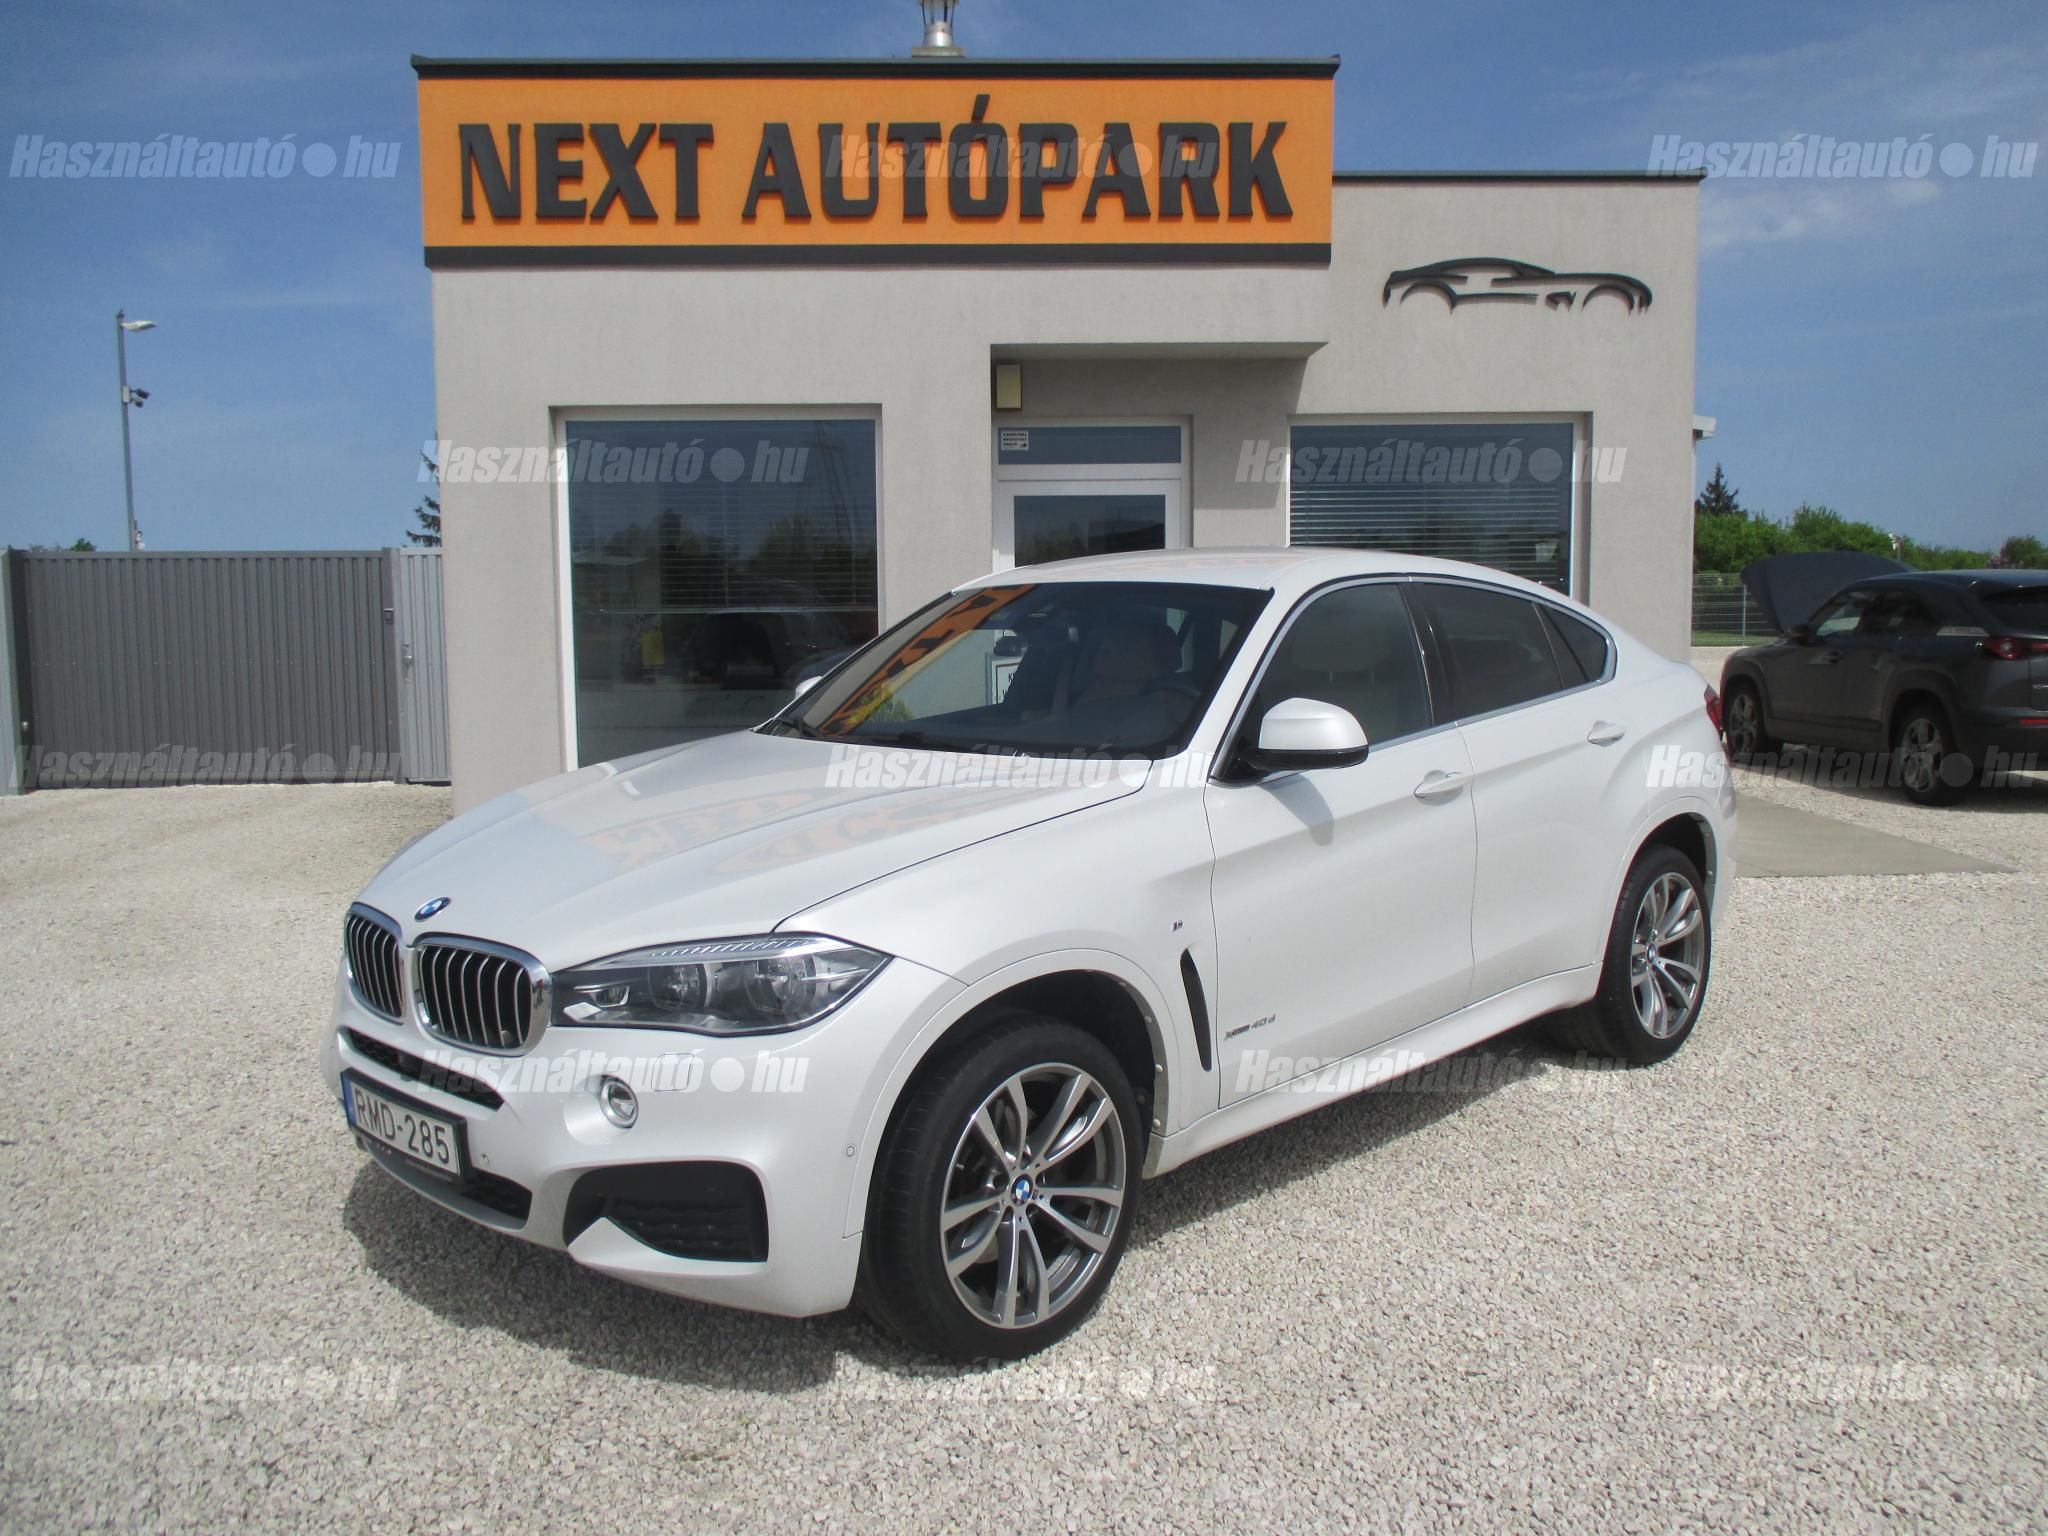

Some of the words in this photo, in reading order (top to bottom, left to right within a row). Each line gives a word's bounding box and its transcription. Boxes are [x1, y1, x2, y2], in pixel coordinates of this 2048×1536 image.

[458, 121, 714, 222] NEXT
[742, 92, 1294, 222] AUTÓPARK
[354, 1087, 450, 1165] RMD-285
